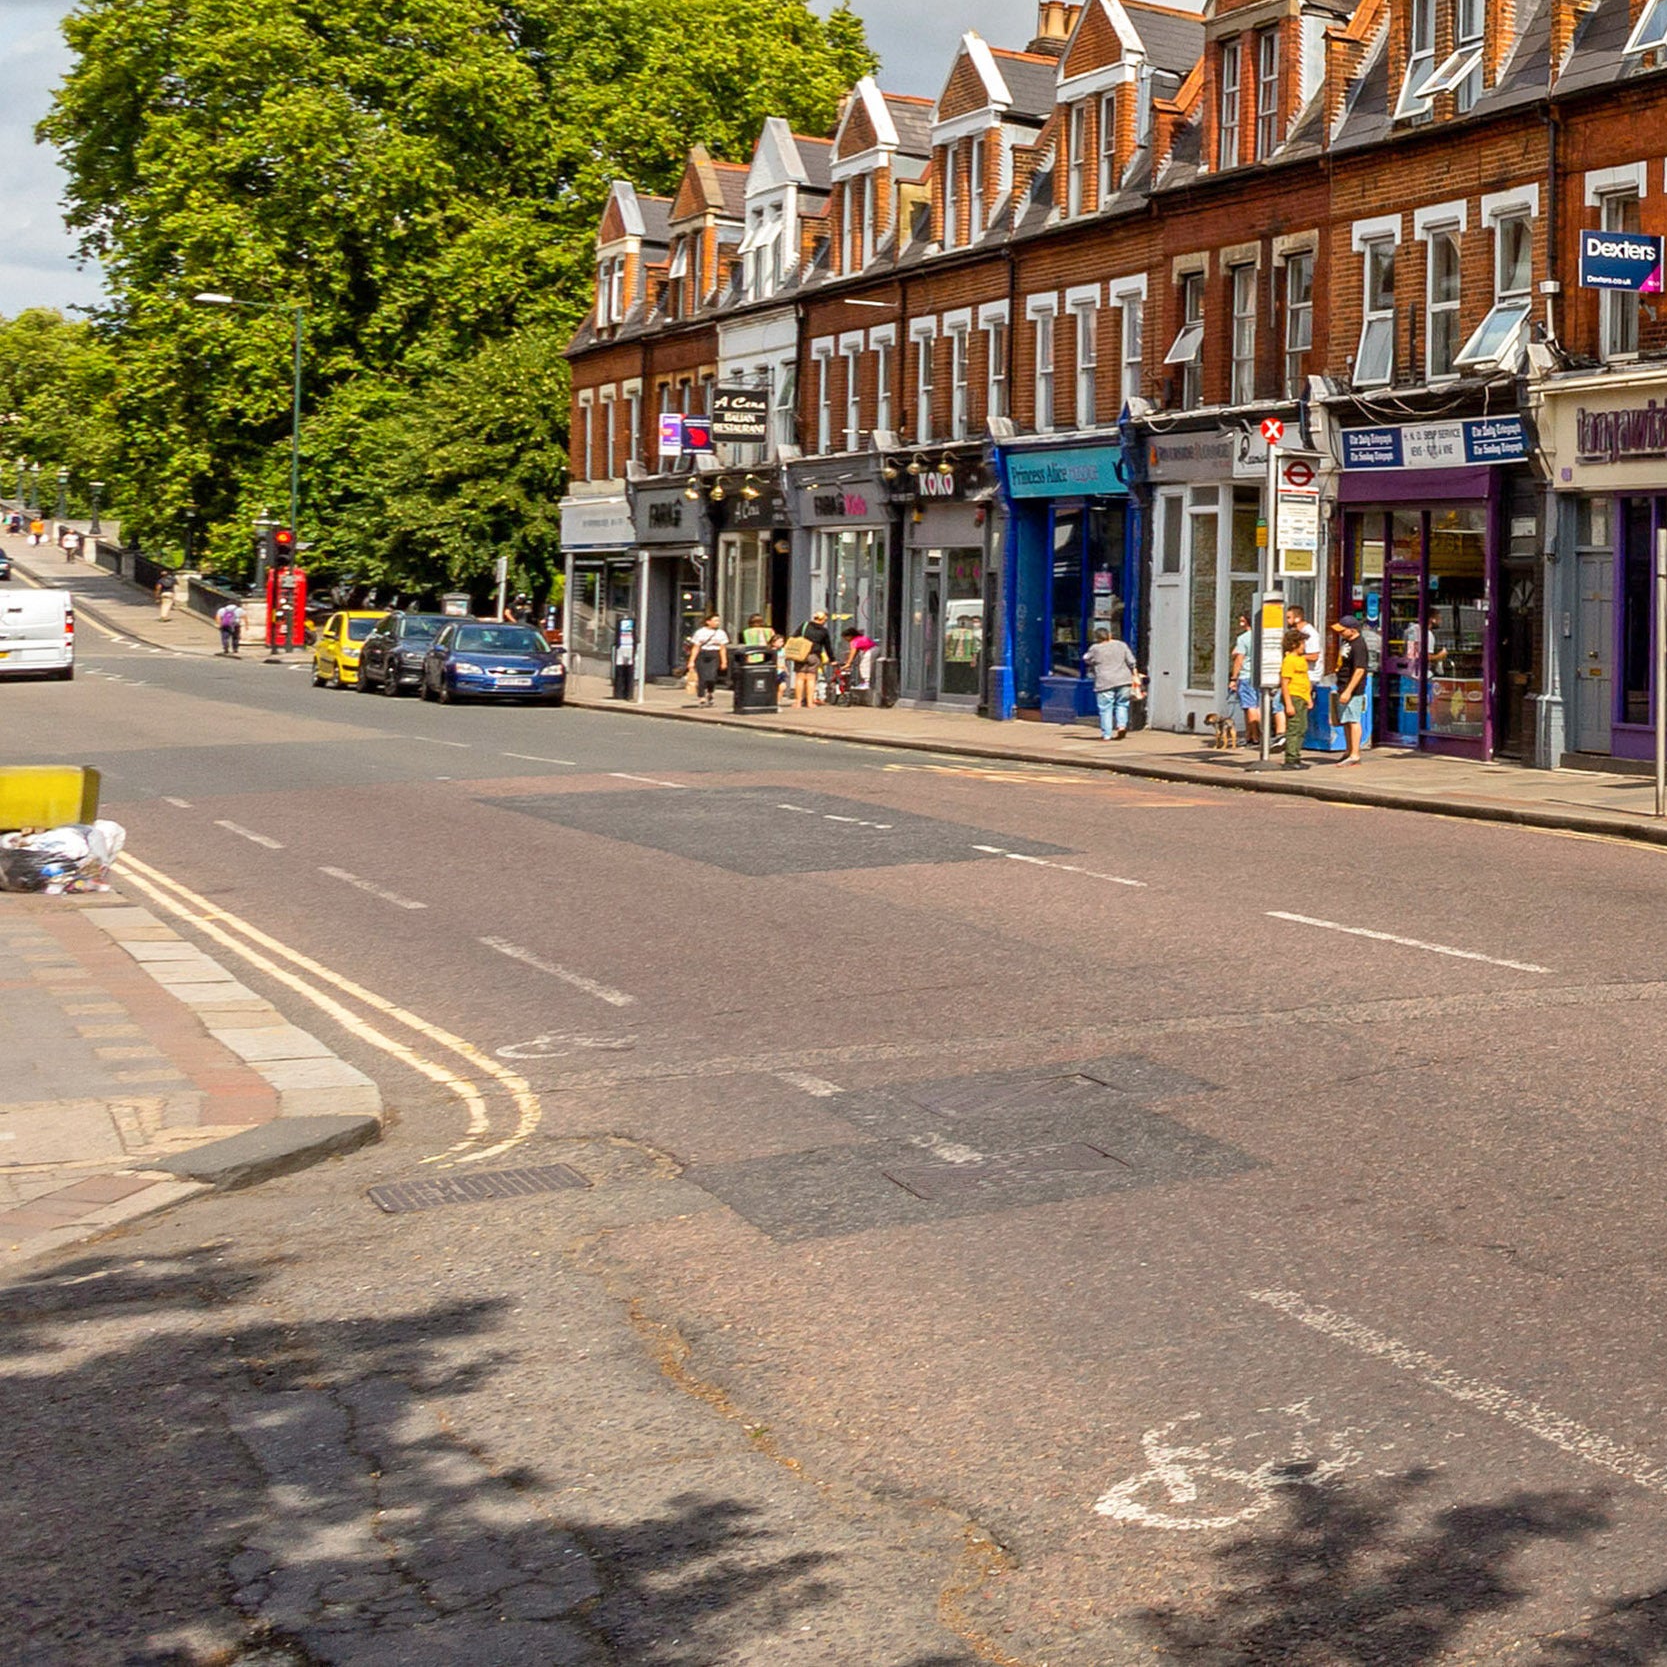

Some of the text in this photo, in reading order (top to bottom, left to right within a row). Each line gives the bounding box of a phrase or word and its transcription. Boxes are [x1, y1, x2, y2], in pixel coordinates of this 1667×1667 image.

[1586, 238, 1656, 261] Dexters
[1586, 275, 1632, 286] Dexters.co.uk
[731, 396, 766, 410] Cena
[724, 413, 756, 423] ITALIAN
[713, 423, 766, 434] RESTAURANT
[1265, 421, 1280, 439] X
[1011, 464, 1045, 486] Princess
[1046, 462, 1068, 484] Alice
[918, 471, 954, 496] KOKO
